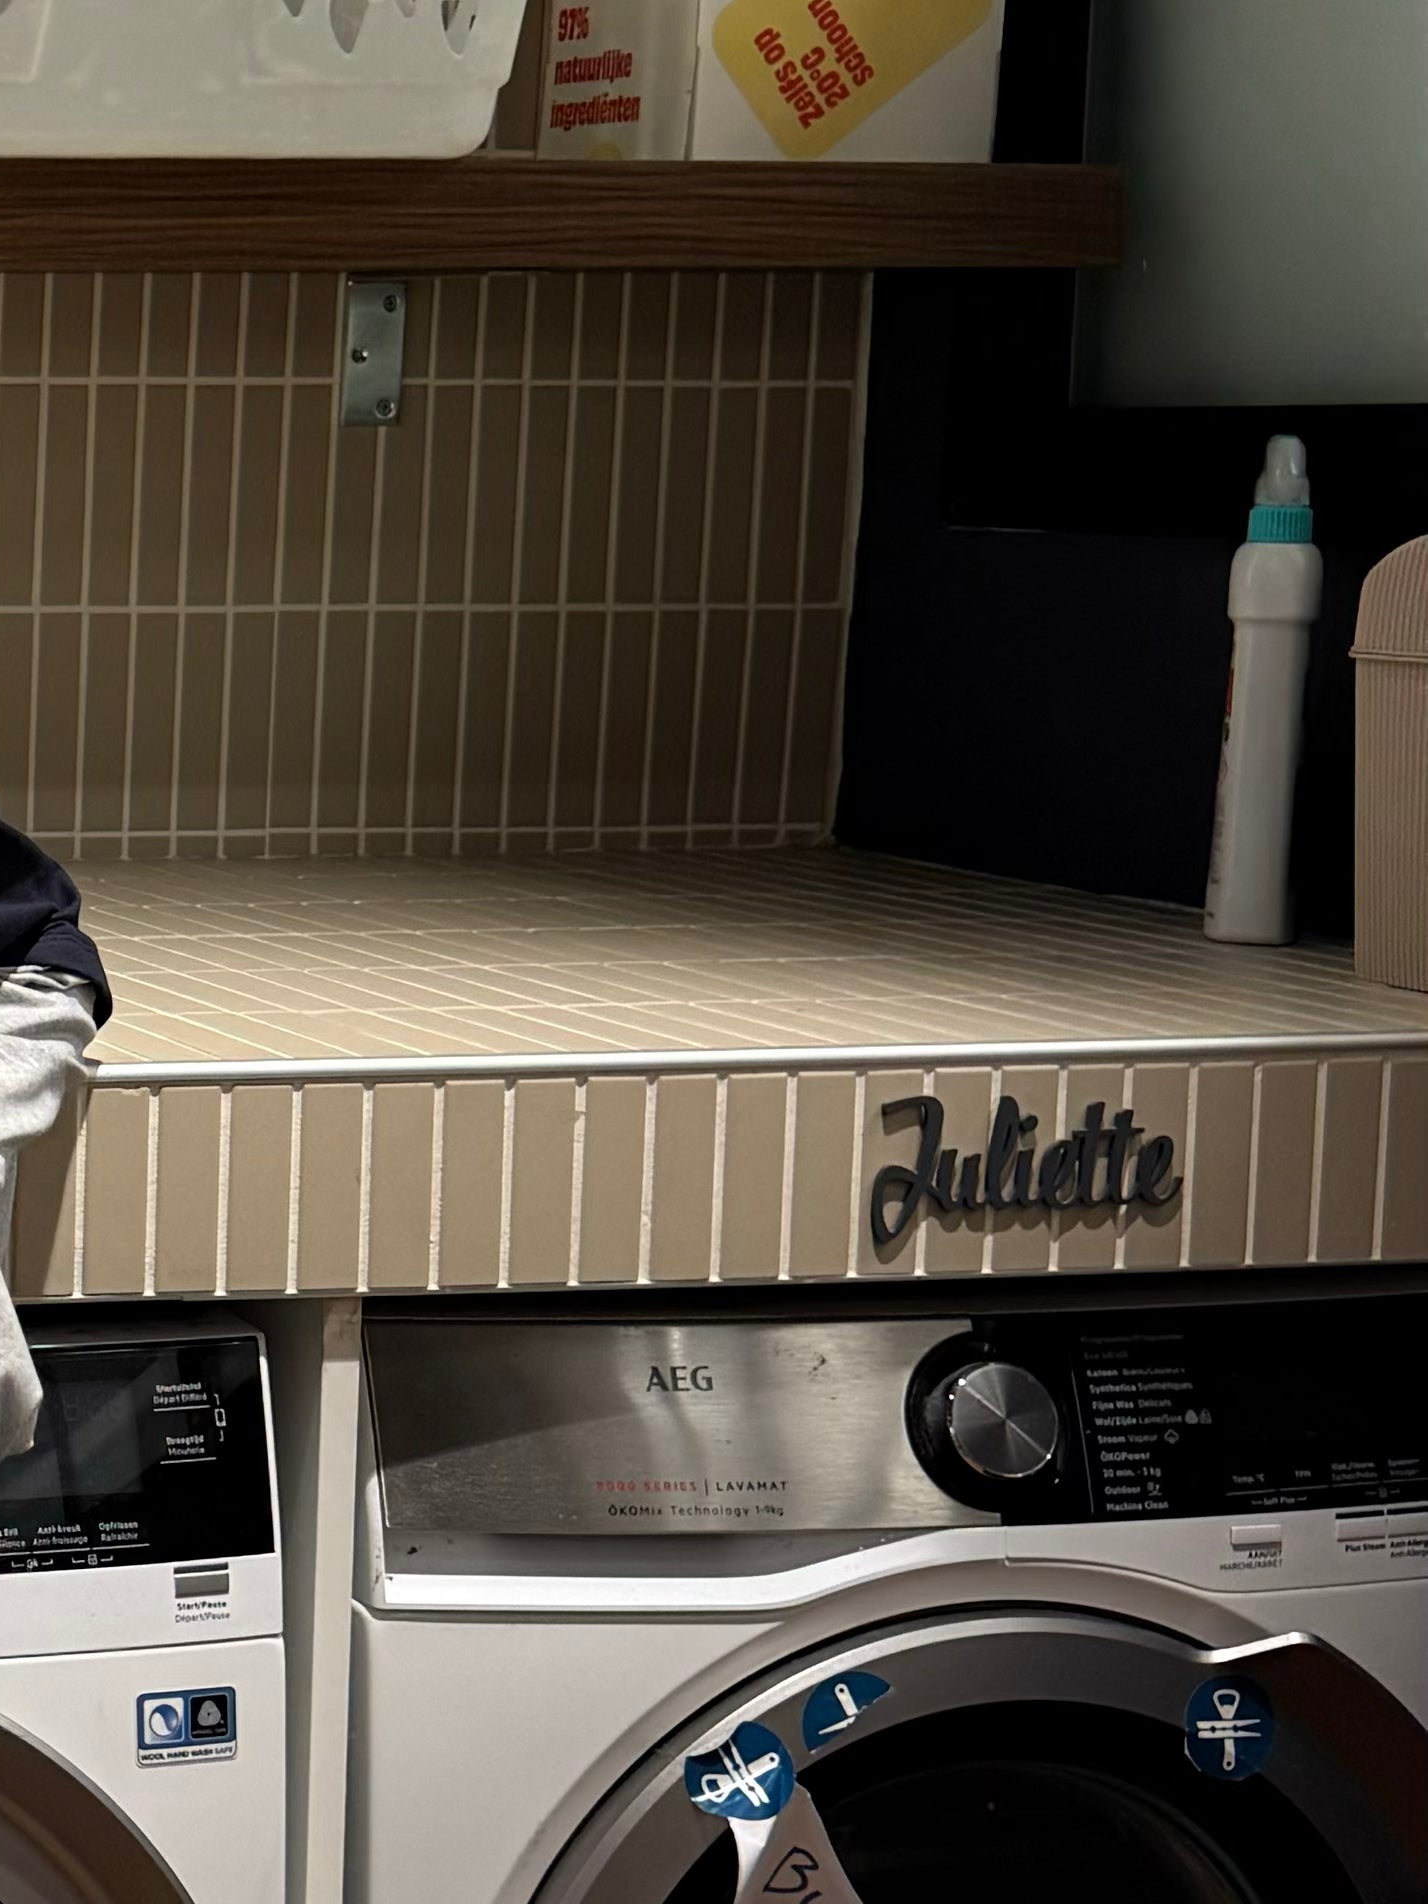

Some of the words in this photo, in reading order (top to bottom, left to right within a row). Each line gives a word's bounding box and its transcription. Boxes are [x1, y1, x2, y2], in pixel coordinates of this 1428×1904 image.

[558, 6, 590, 42] 97%
[753, 27, 786, 65] op
[554, 49, 633, 85] natuurlijke
[871, 1095, 1184, 1244] Juliette
[646, 1365, 714, 1393] AEG
[716, 1480, 788, 1492] LAVAMAT
[671, 1504, 749, 1517] Technology
